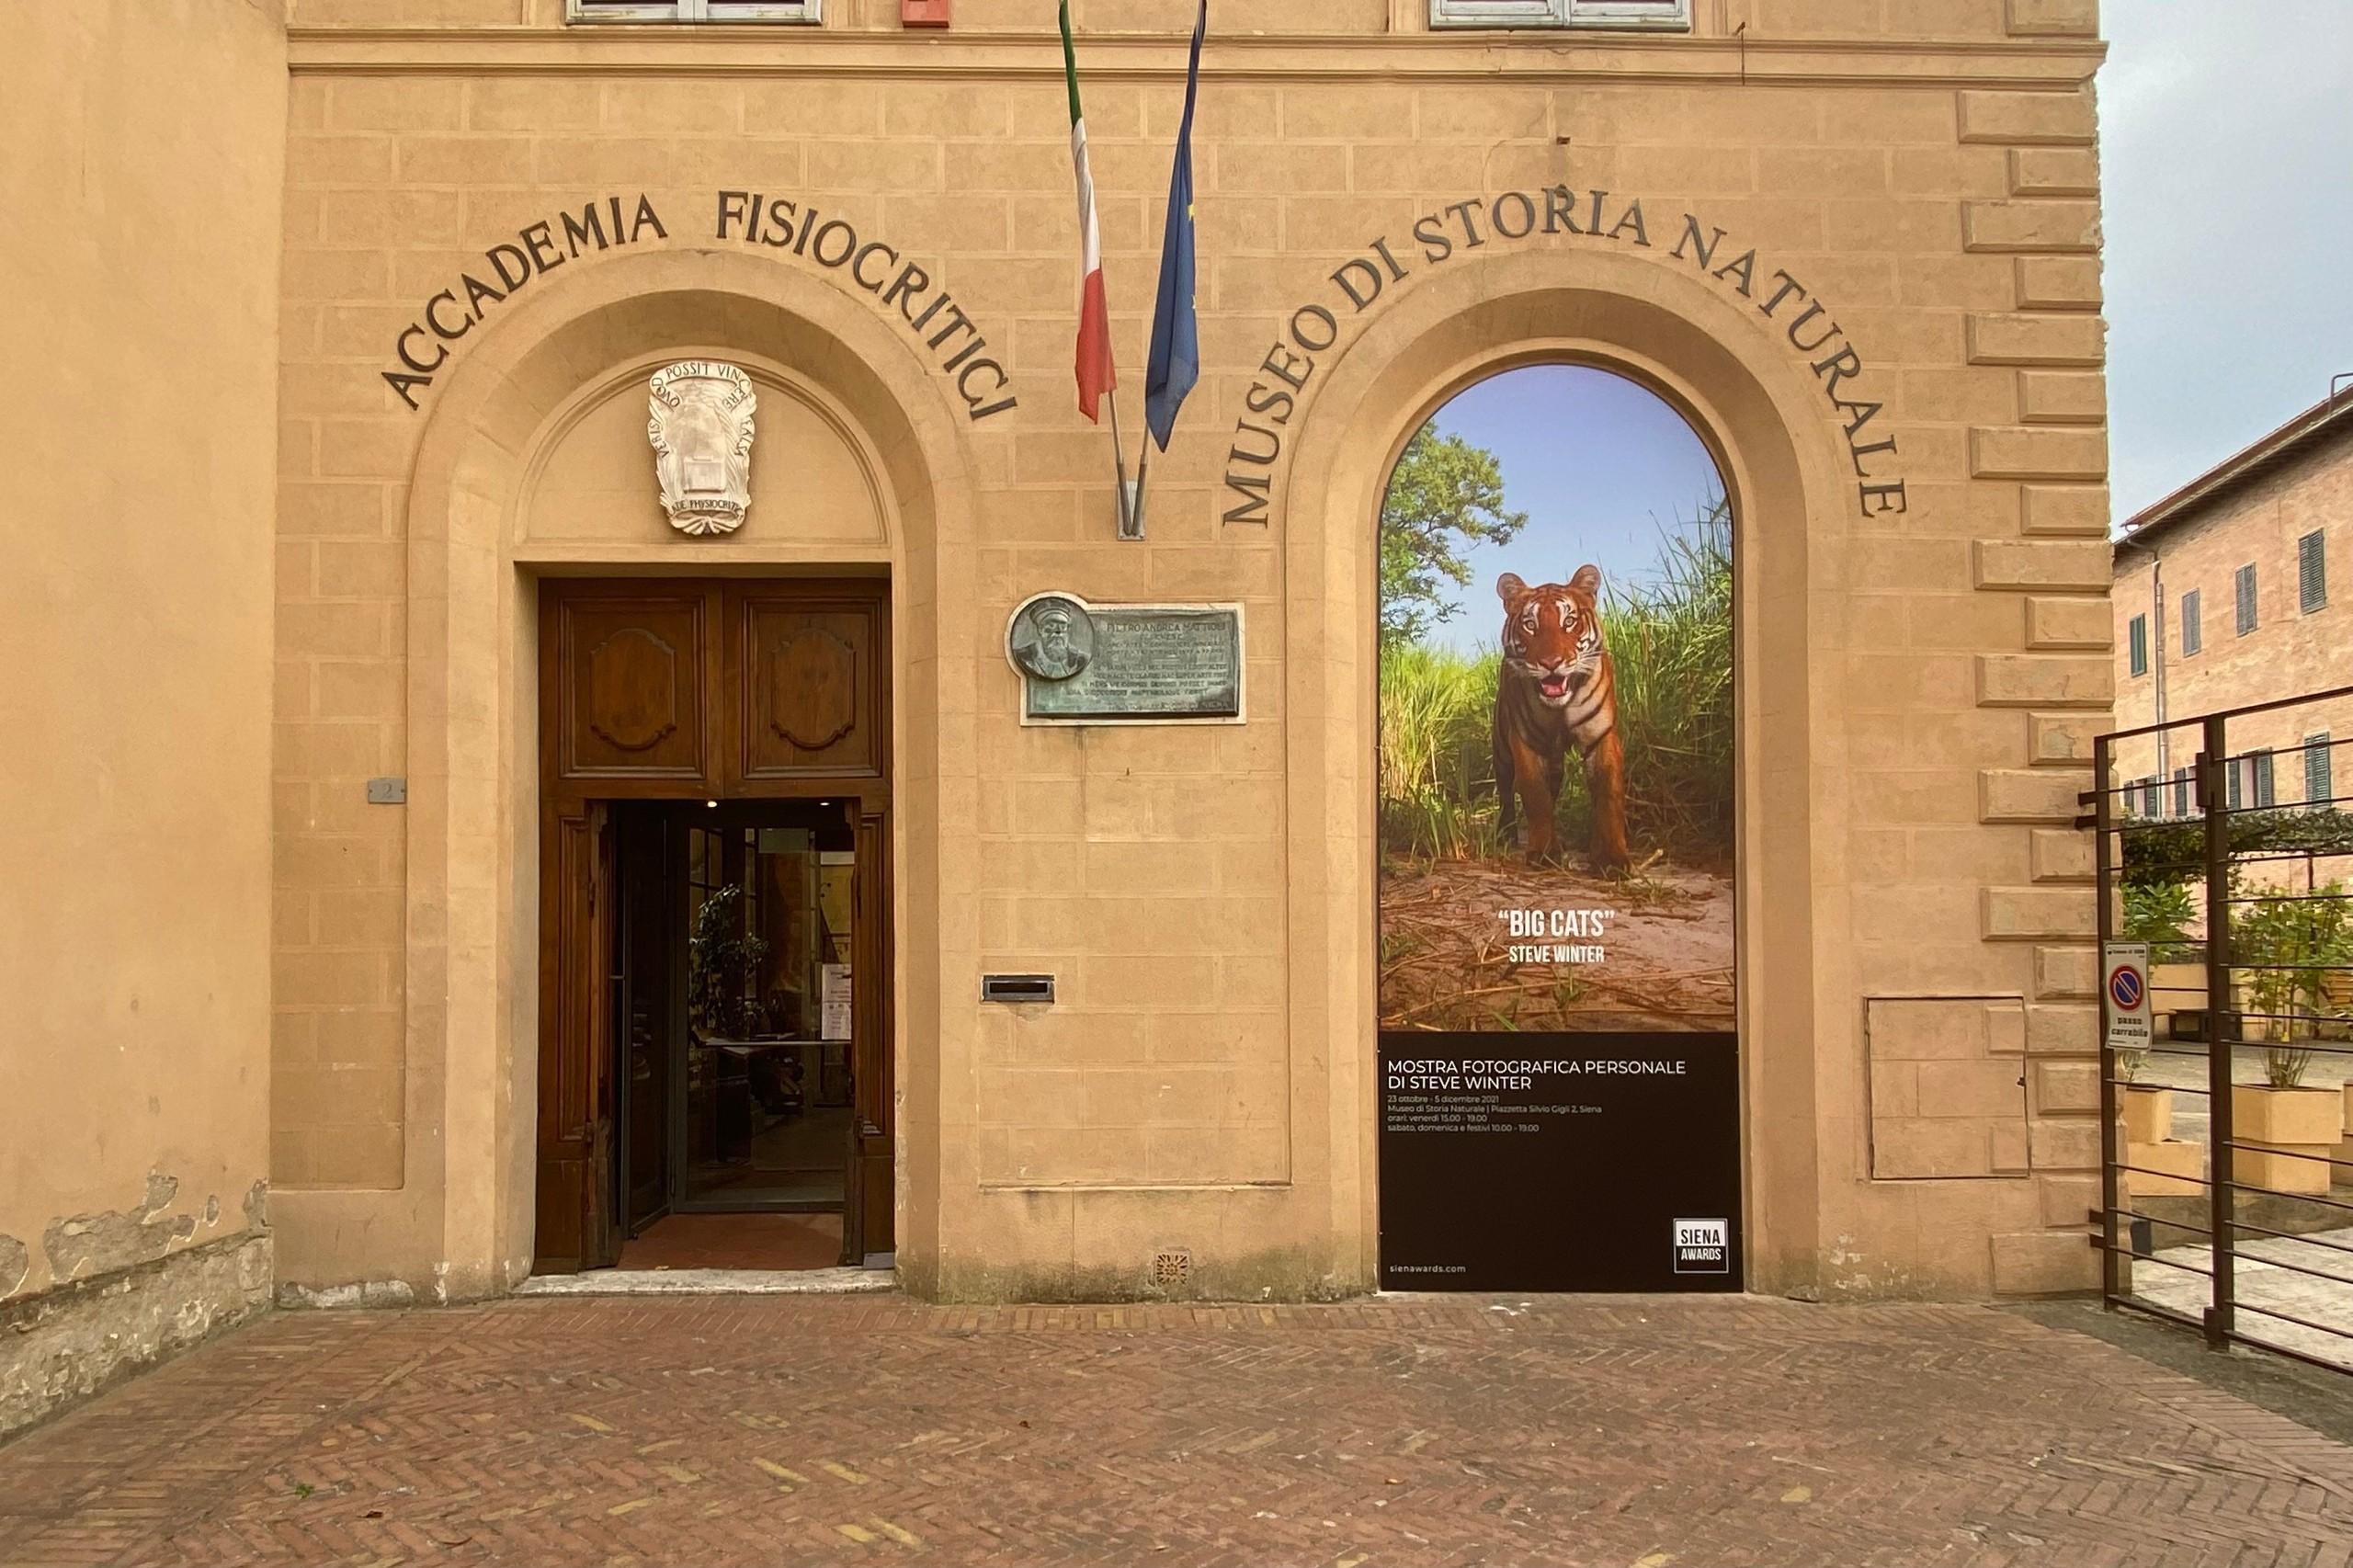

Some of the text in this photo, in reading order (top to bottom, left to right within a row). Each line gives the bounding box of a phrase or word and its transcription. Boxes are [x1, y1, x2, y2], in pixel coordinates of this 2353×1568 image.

[381, 190, 1017, 420] ACCADEMIA FISIOCRITICI
[1222, 184, 1907, 530] MUSEO DI STORIA NATURALE
[665, 361, 709, 380] POSSIT
[1509, 945, 1605, 963] STEVE WINTER
[1388, 1060, 1687, 1074] MOSTRA FOTOGRAFICA PERSONALE
[1388, 1075, 1532, 1090] DI STEVE WINTER
[1387, 1095, 1397, 1103] 23
[1398, 1095, 1428, 1103] ottobre
[1435, 1095, 1440, 1103] 5
[1441, 1095, 1481, 1103] dicembre
[1388, 1105, 1415, 1113] Museo
[1416, 1105, 1425, 1113] di
[1425, 1105, 1449, 1113] Storia
[1450, 1105, 1485, 1113] Naturale
[1491, 1105, 1528, 1113] Piazzetta
[1529, 1105, 1551, 1113] Silvio
[1552, 1105, 1571, 1115] Gigli
[1579, 1105, 1603, 1114] Siena
[1491, 1124, 1513, 1132] 10.00
[1518, 1124, 1540, 1132] 19.00
[1680, 1229, 1721, 1244] SIENA
[1680, 1247, 1722, 1261] AWARDS
[1390, 1265, 1467, 1273] sienawards.com
